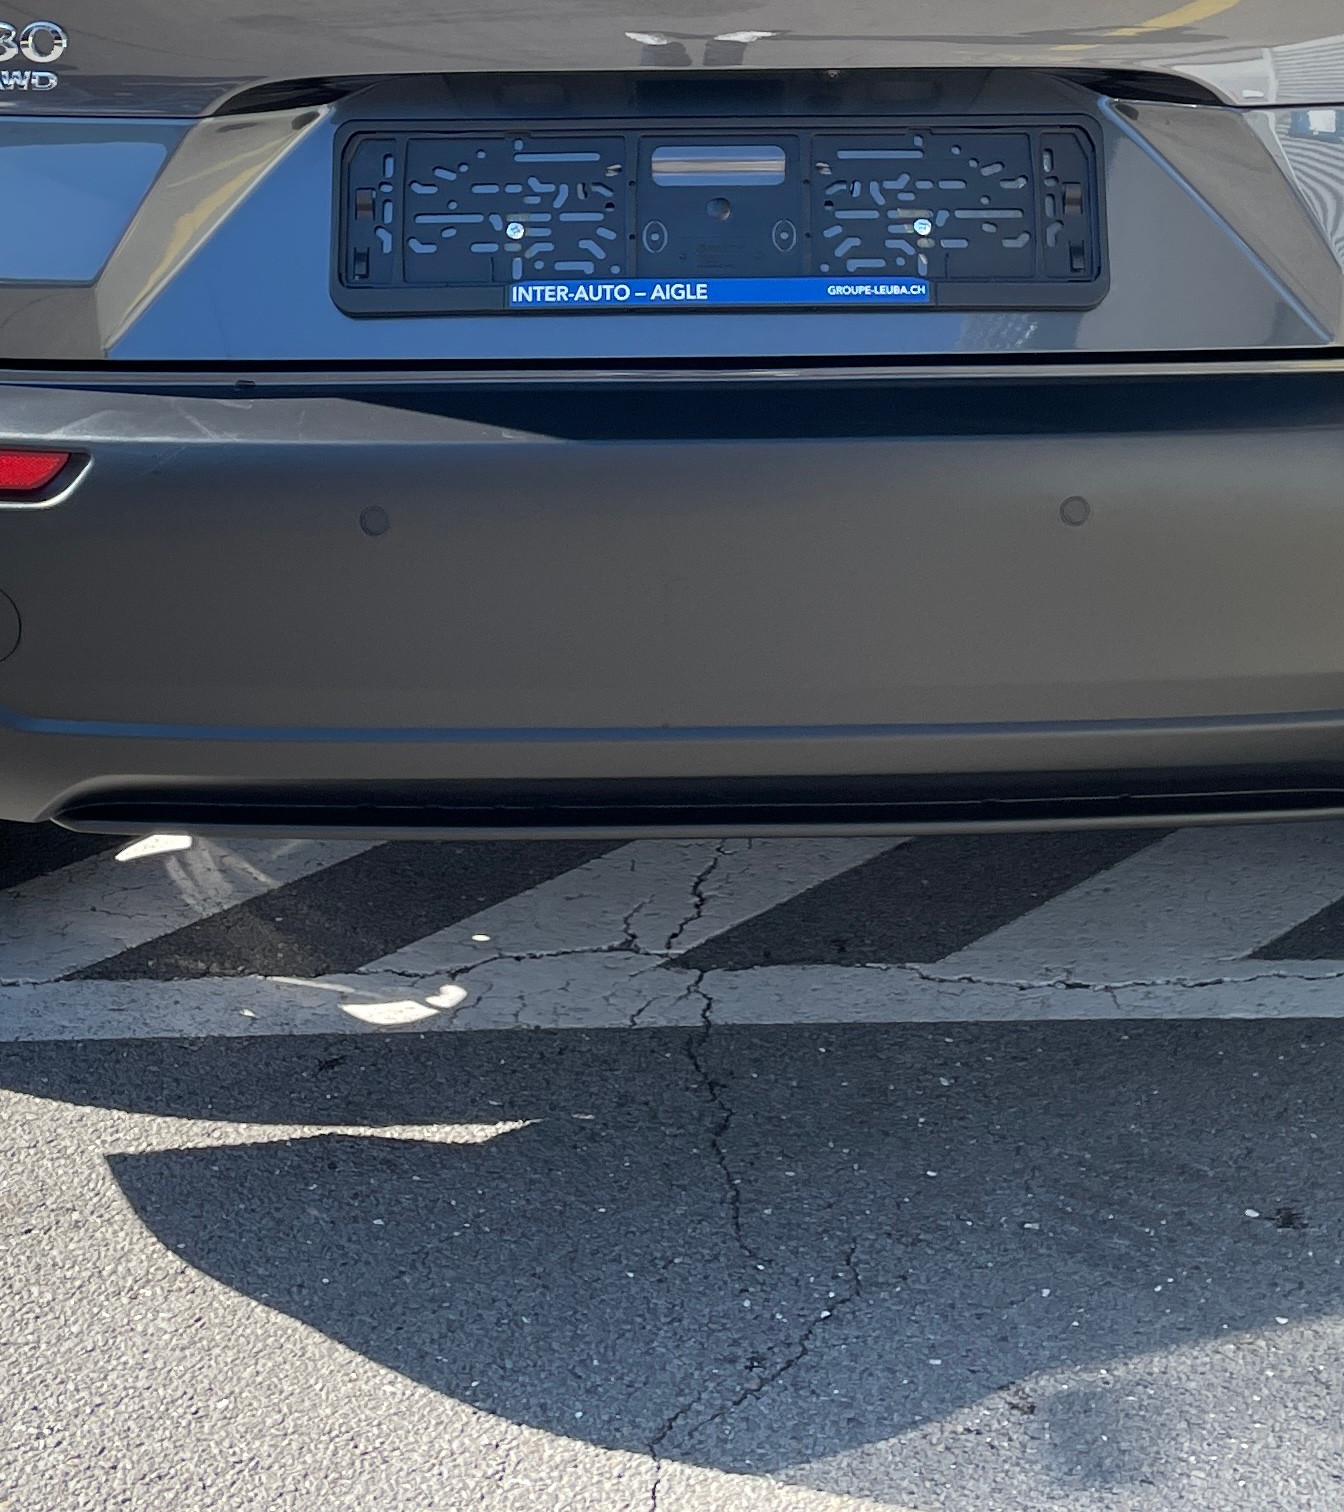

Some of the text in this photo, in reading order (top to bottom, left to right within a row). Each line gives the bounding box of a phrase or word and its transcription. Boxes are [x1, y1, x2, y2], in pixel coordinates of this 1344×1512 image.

[512, 285, 631, 302] INTER-AUTO
[650, 284, 708, 301] AIGLE
[827, 284, 926, 296] GROUPE-LEUBA.CH
